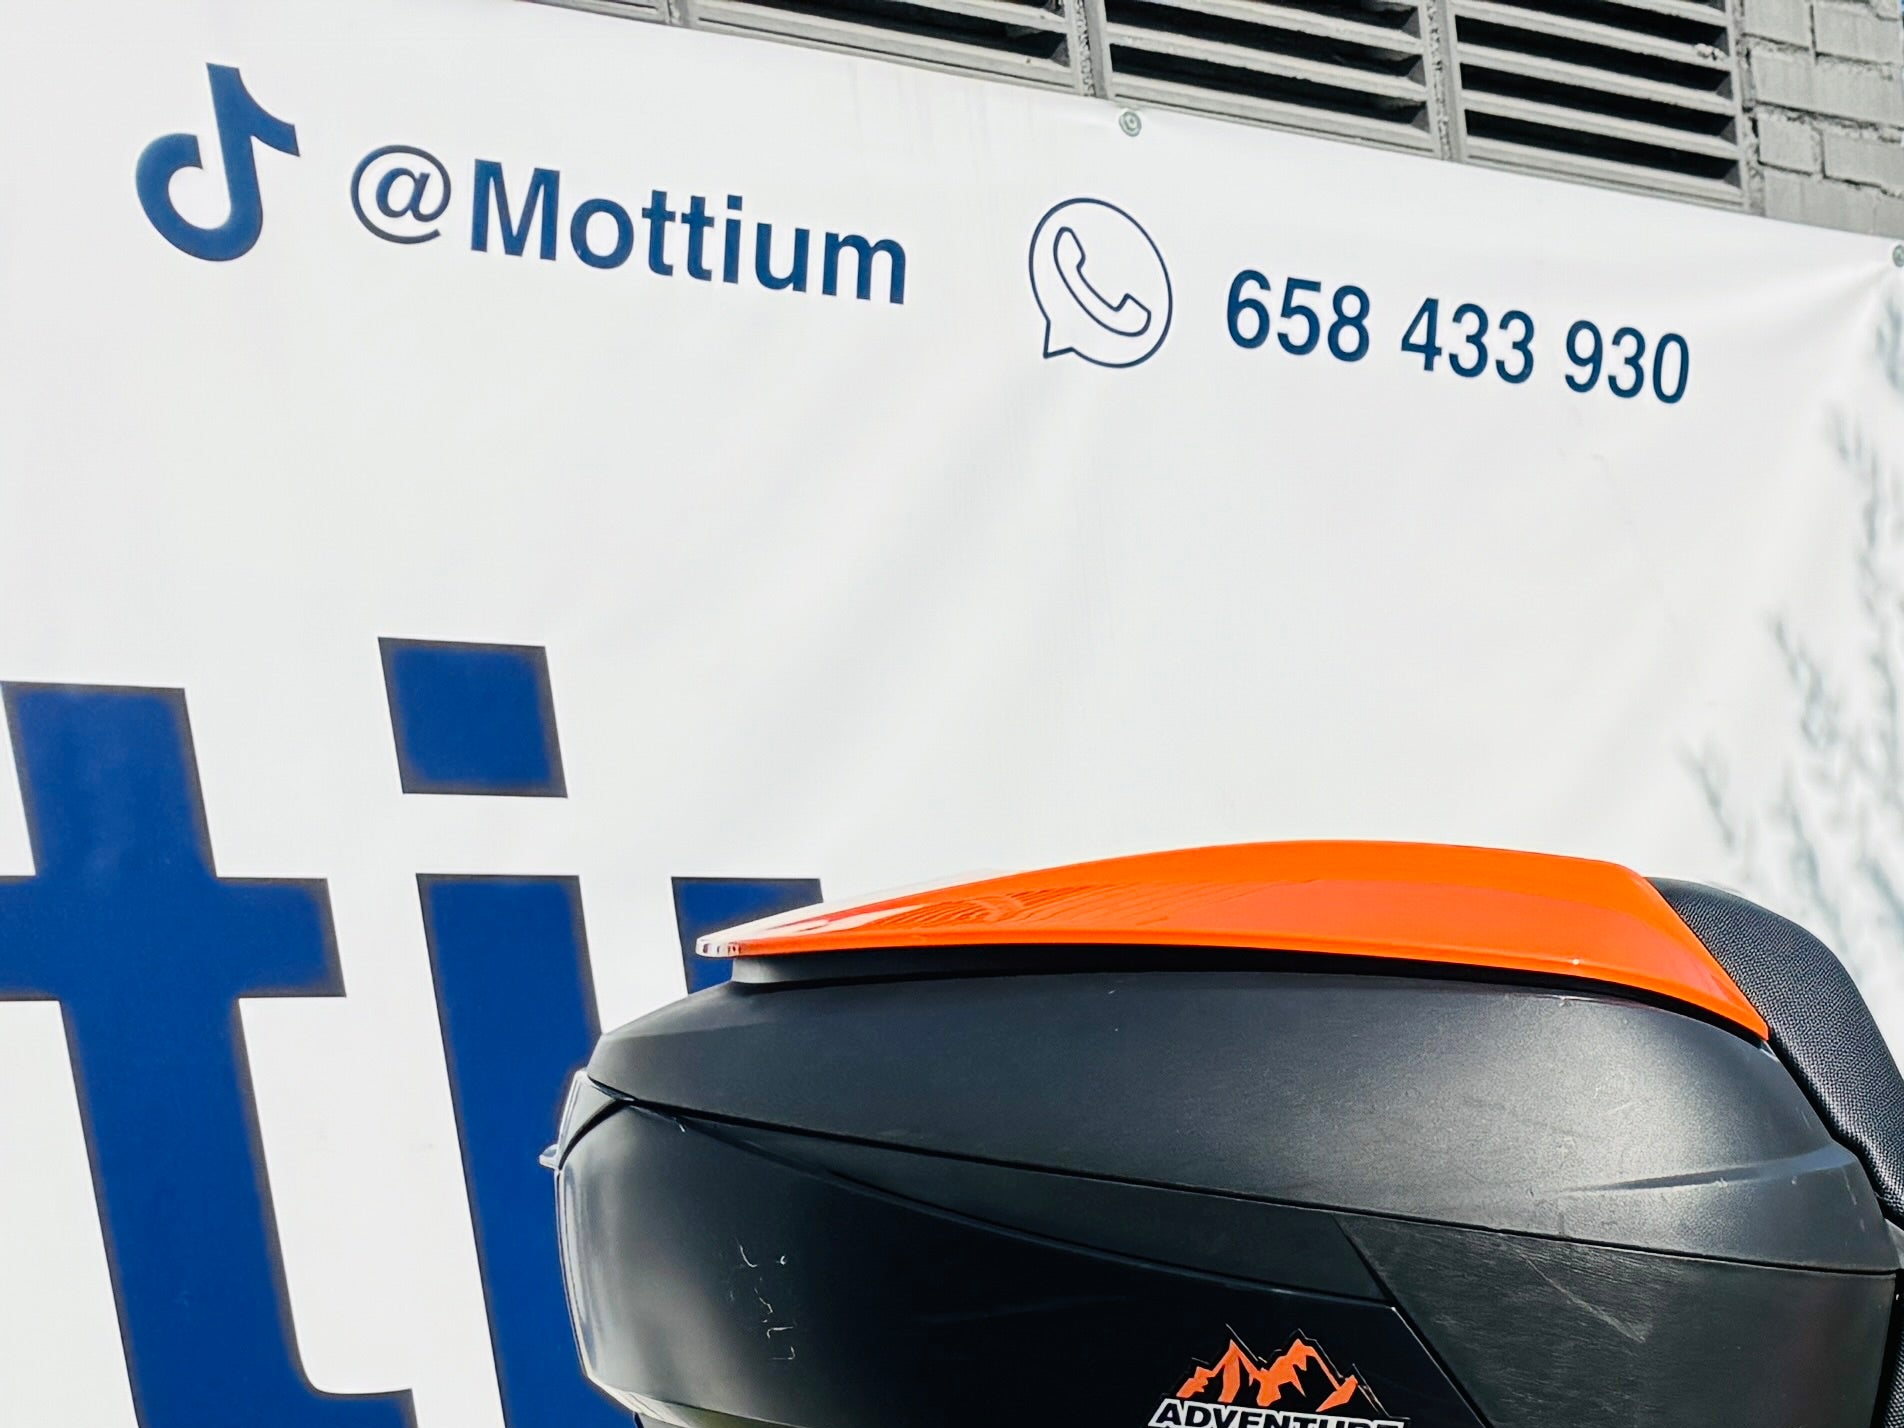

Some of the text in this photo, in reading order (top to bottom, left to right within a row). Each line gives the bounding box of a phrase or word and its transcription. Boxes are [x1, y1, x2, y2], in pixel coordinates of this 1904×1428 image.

[350, 145, 907, 306] @Mottium
[1226, 269, 1691, 404] 658 433 930
